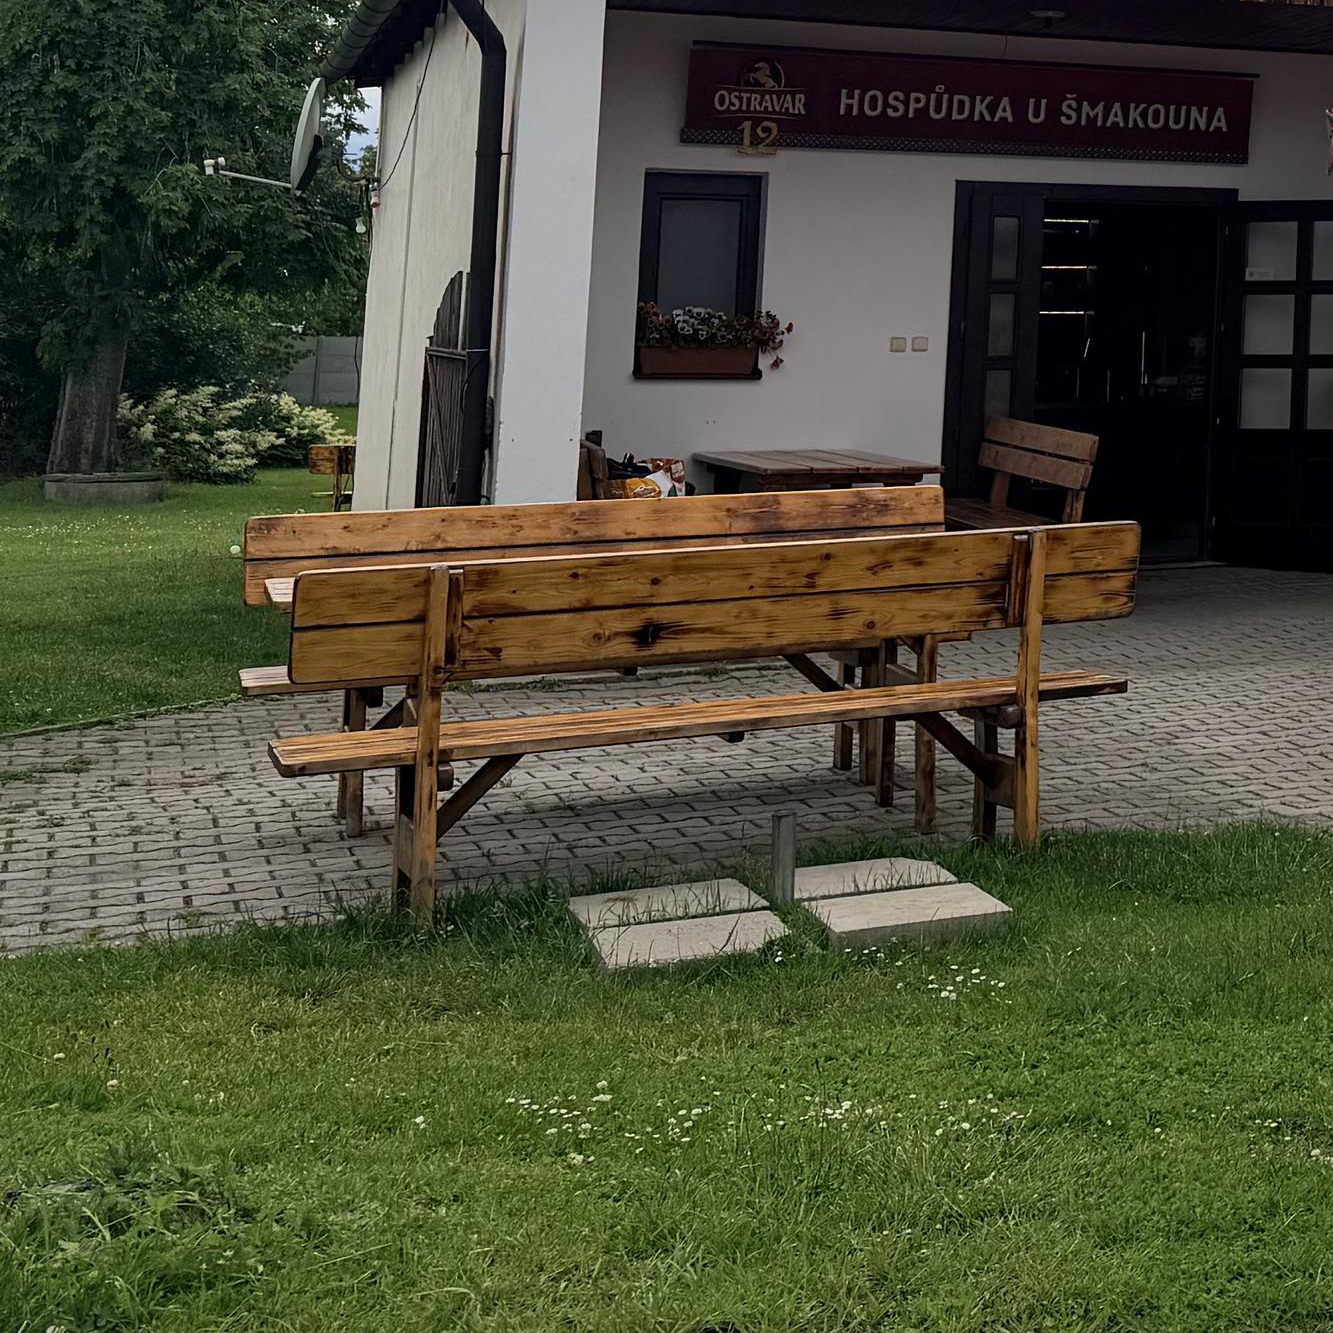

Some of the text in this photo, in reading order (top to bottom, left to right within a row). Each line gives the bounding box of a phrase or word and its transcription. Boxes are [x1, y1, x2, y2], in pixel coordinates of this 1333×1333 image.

[714, 89, 807, 115] OSTRAVAR
[839, 84, 1229, 132] HOSPŮDKA U ŠMAKOUNA
[736, 120, 779, 156] 12
